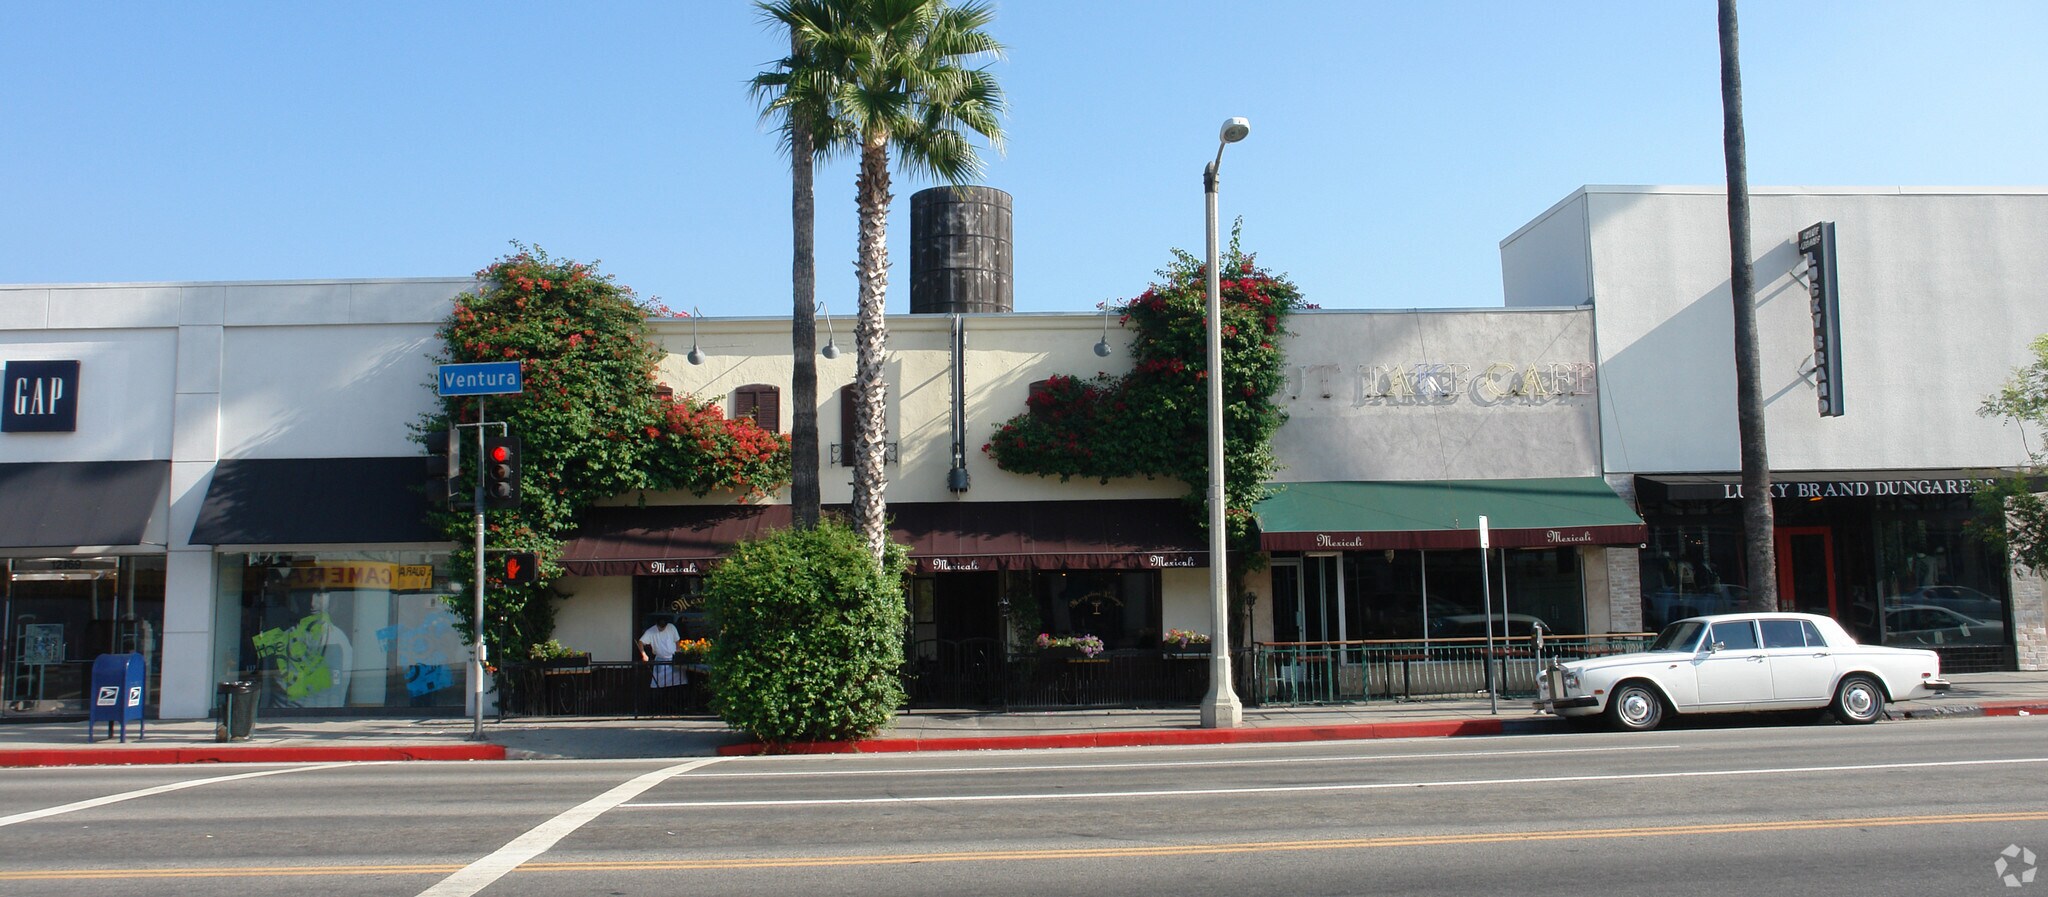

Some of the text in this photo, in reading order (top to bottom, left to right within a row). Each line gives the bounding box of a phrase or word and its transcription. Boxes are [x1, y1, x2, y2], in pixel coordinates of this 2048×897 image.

[1806, 251, 1822, 329] LUCKY
[444, 371, 516, 388] Ventura
[1284, 361, 1596, 397] UT TAKE CAFE
[14, 377, 63, 416] GAP
[1797, 481, 1869, 498] BRAND
[1875, 478, 1995, 496] DUNGARES
[1316, 533, 1365, 547] Mexicali
[1546, 530, 1593, 543] Mexicali
[651, 561, 698, 574] Mexicali
[932, 558, 980, 571] Mexicali
[1150, 554, 1196, 567] Mexicali
